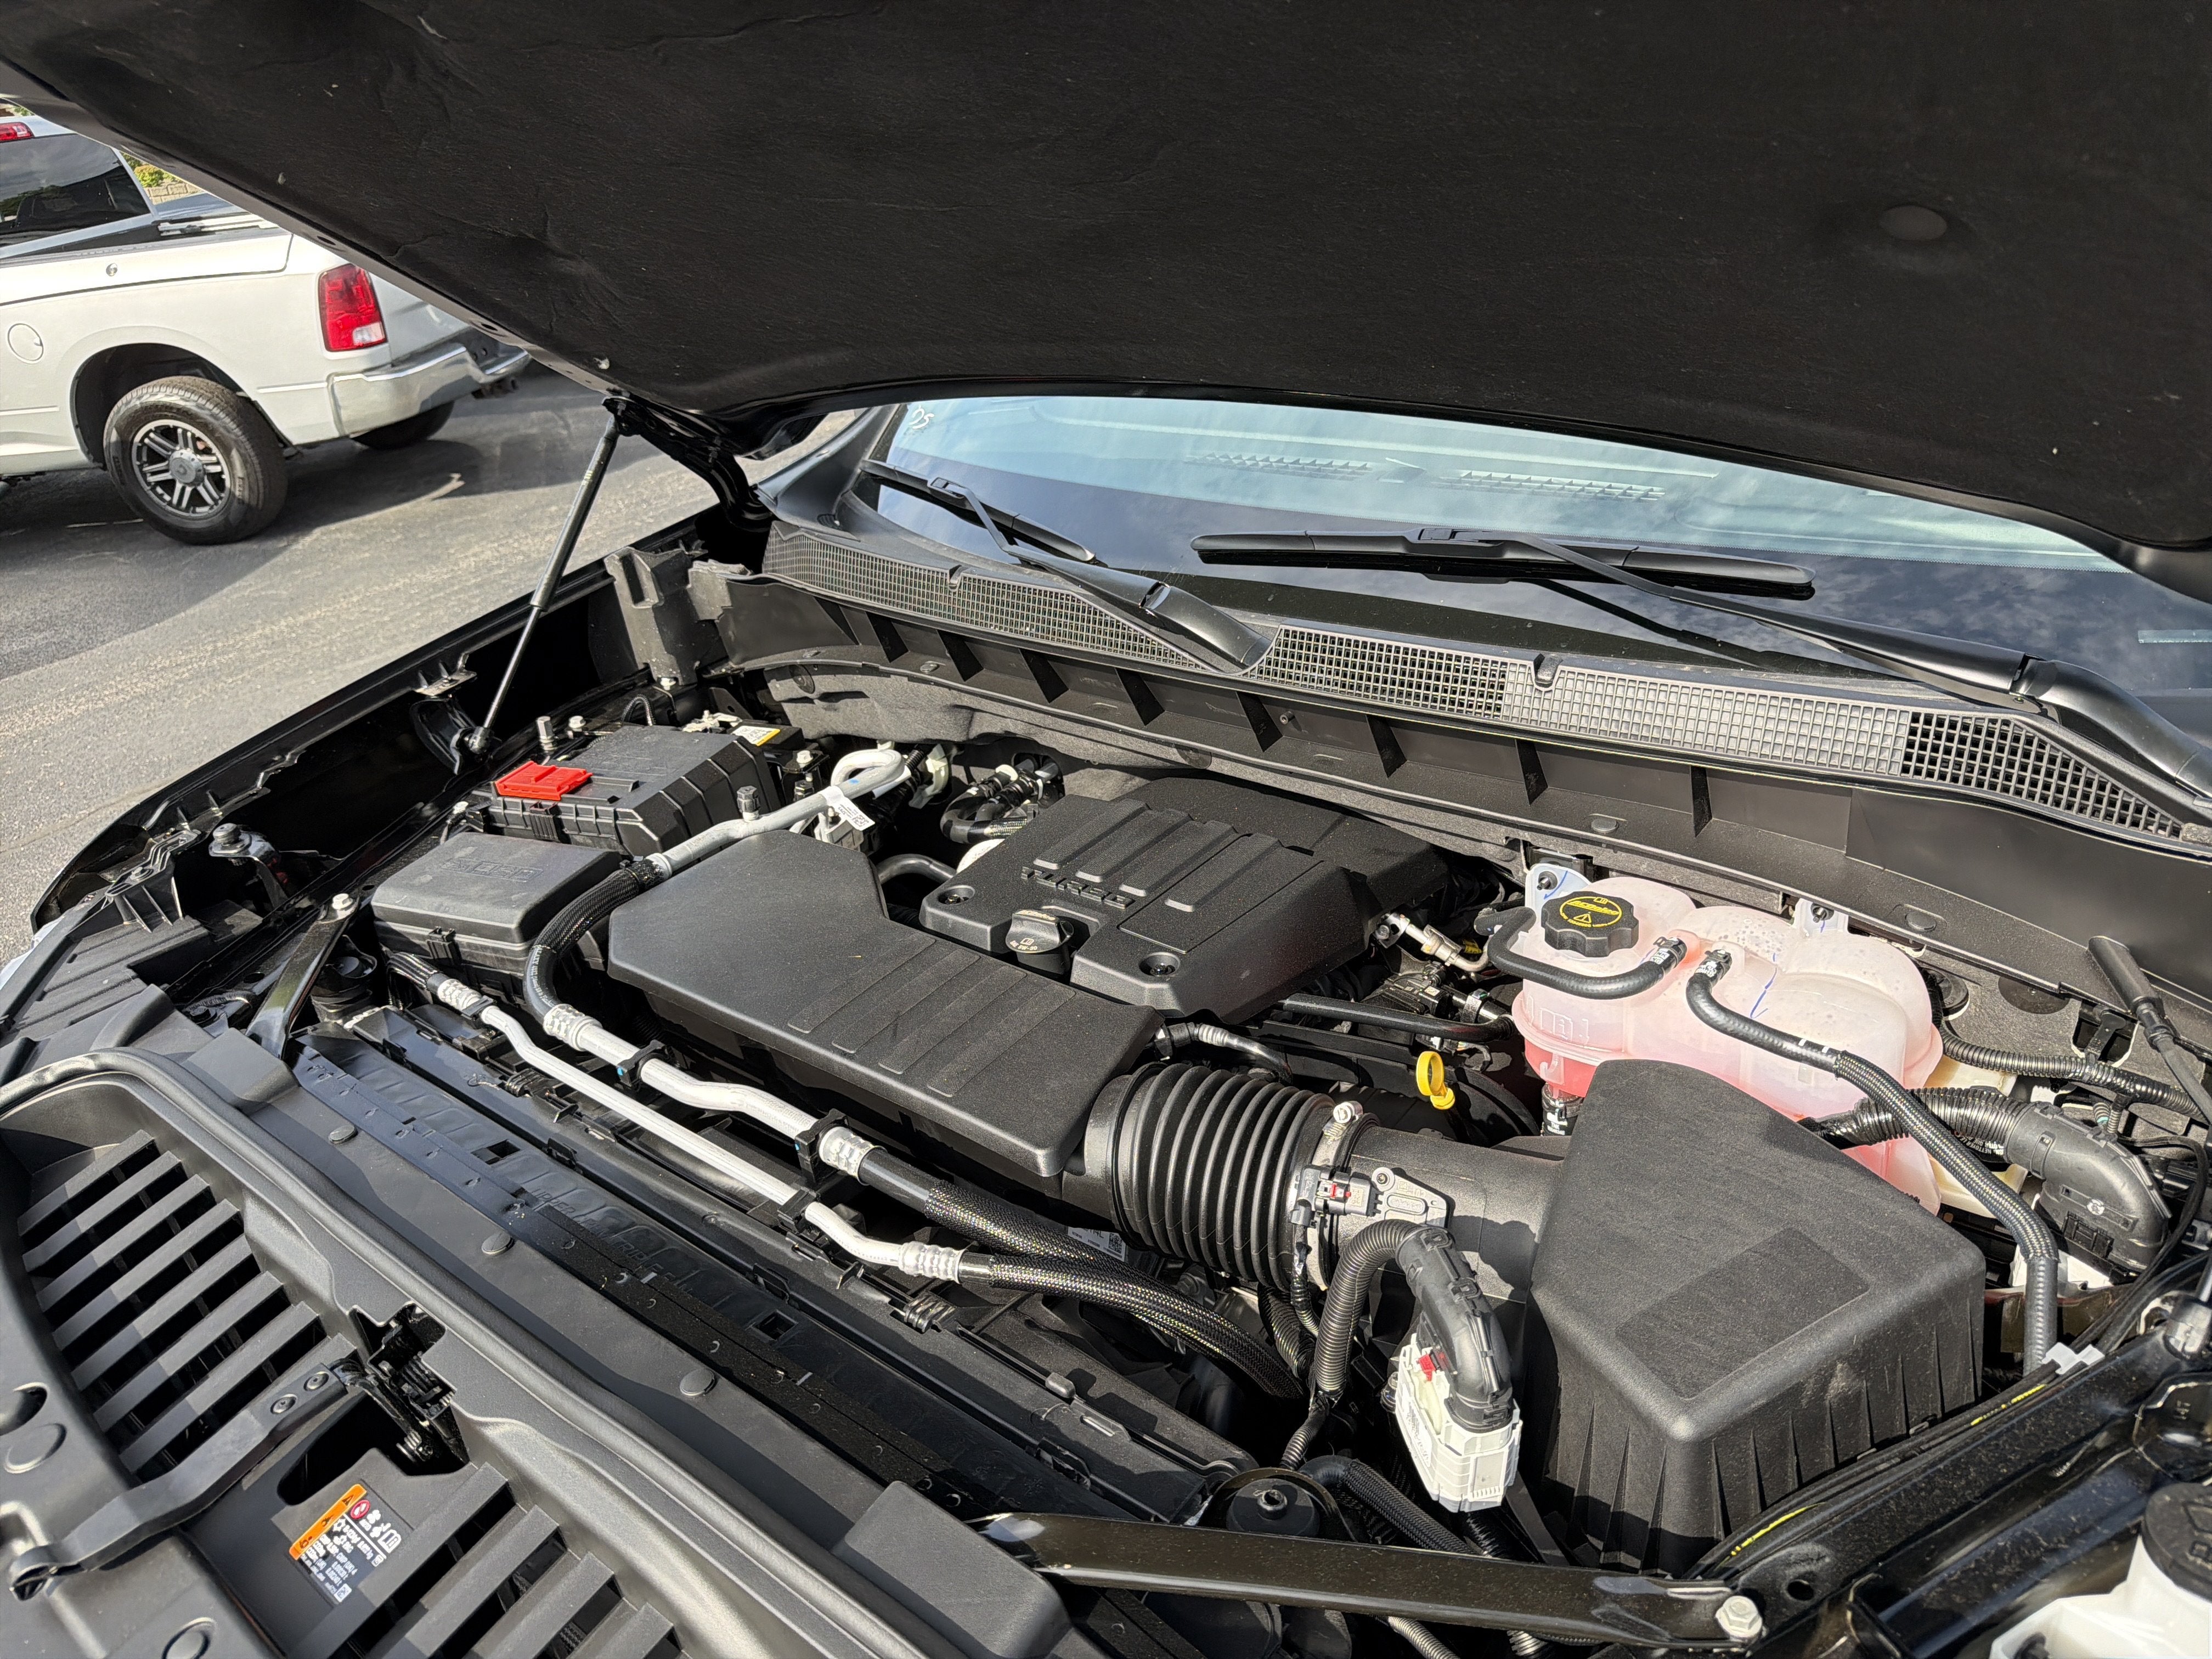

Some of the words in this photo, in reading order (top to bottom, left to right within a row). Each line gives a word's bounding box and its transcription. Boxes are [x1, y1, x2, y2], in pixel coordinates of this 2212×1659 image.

[1022, 866, 1136, 909] TURBO
[336, 1551, 348, 1564] GWP
[343, 1560, 355, 1572] (UK)
